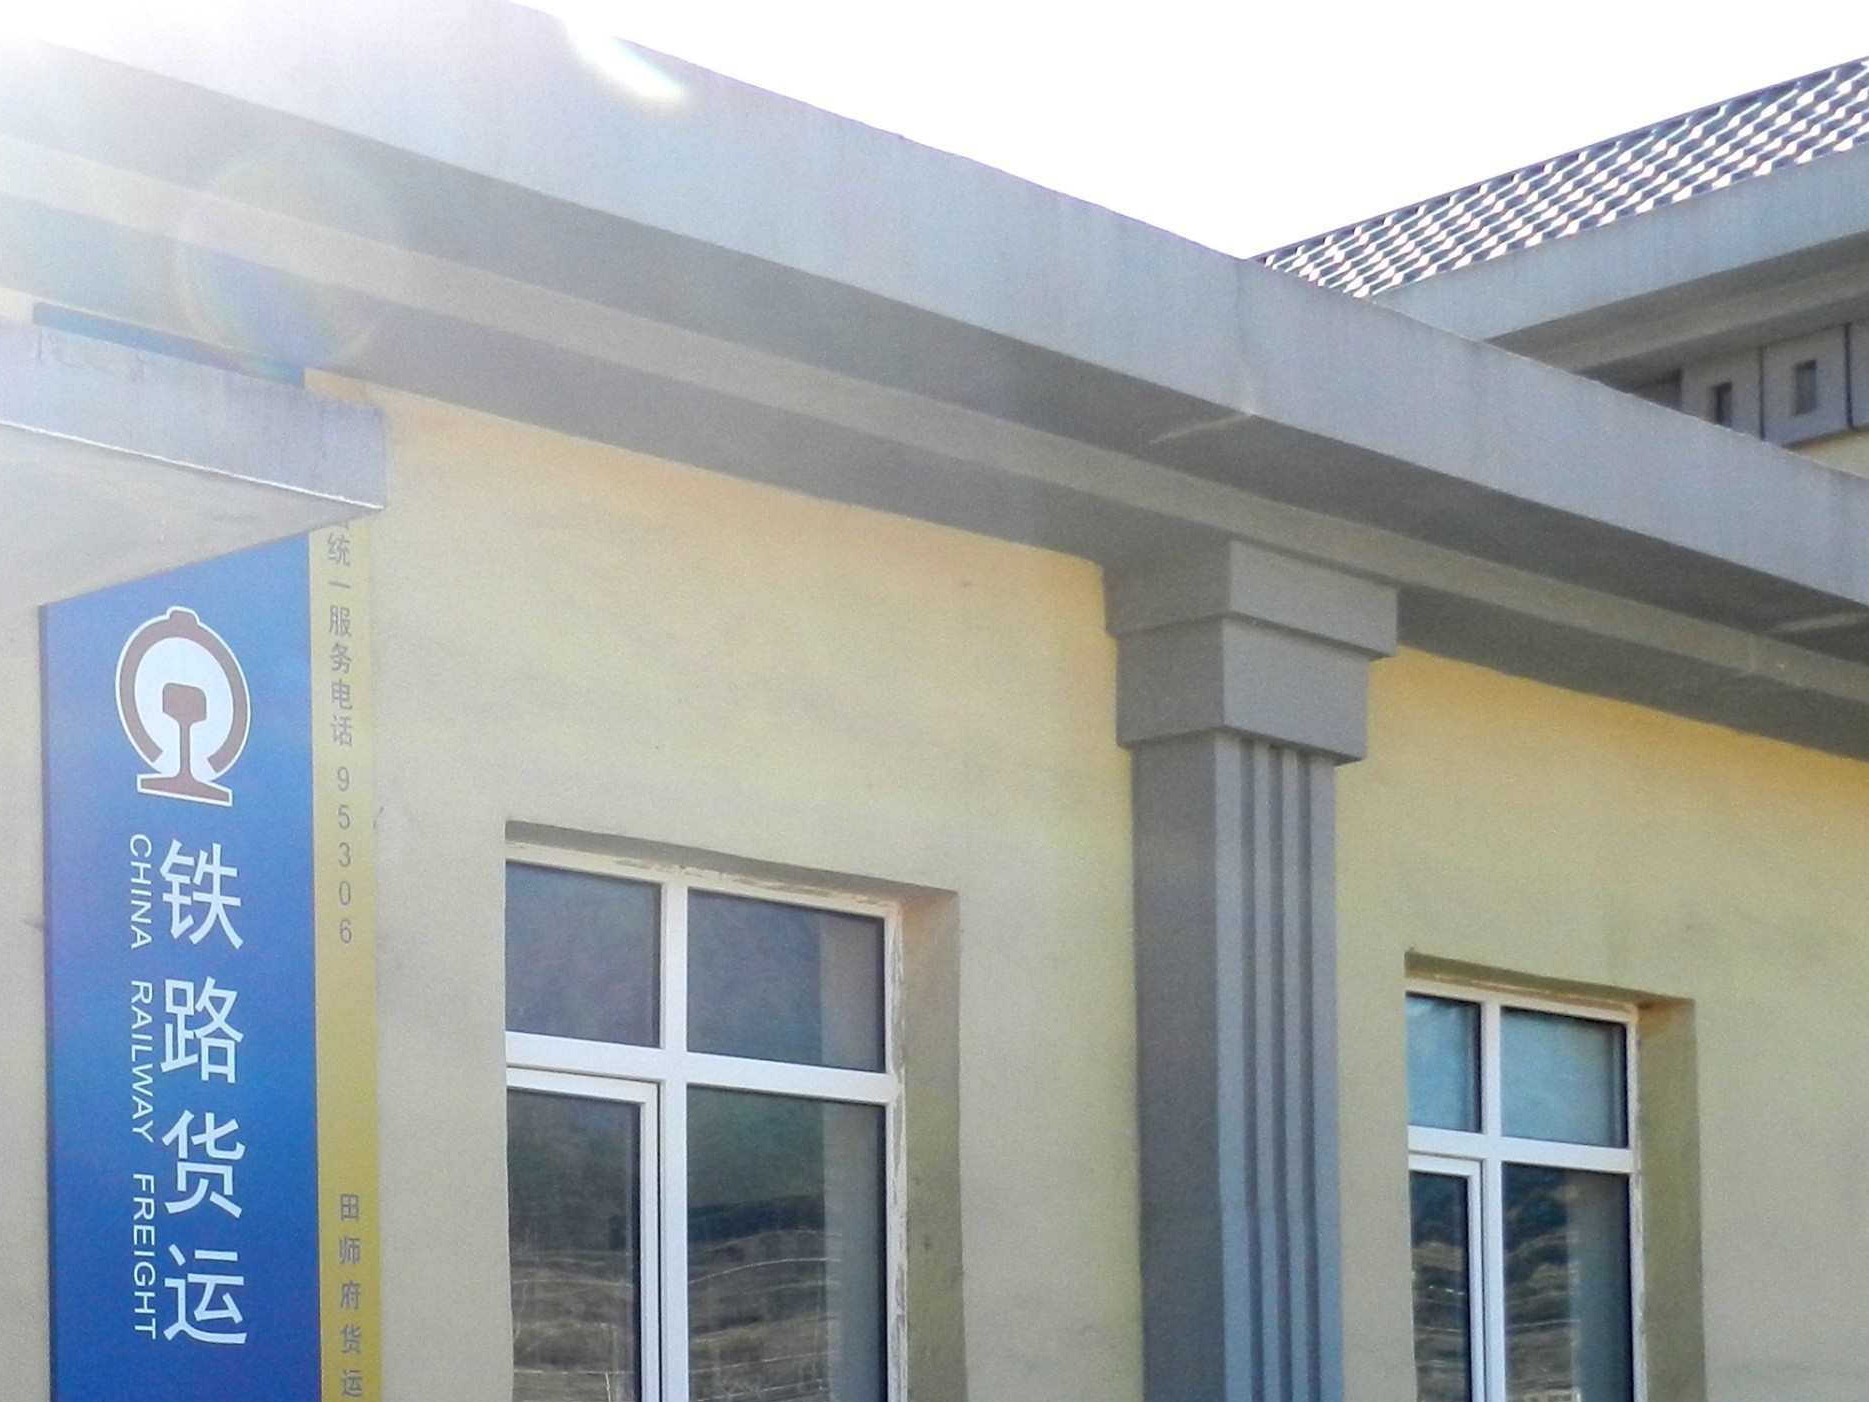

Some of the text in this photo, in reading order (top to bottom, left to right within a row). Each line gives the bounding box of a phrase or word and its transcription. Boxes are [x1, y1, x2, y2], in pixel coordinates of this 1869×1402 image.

[326, 519, 355, 945] 统一服务电话 95306
[129, 833, 157, 1340] CHINA RAILWAY FREIGHT
[159, 838, 248, 1346] 铁路货运
